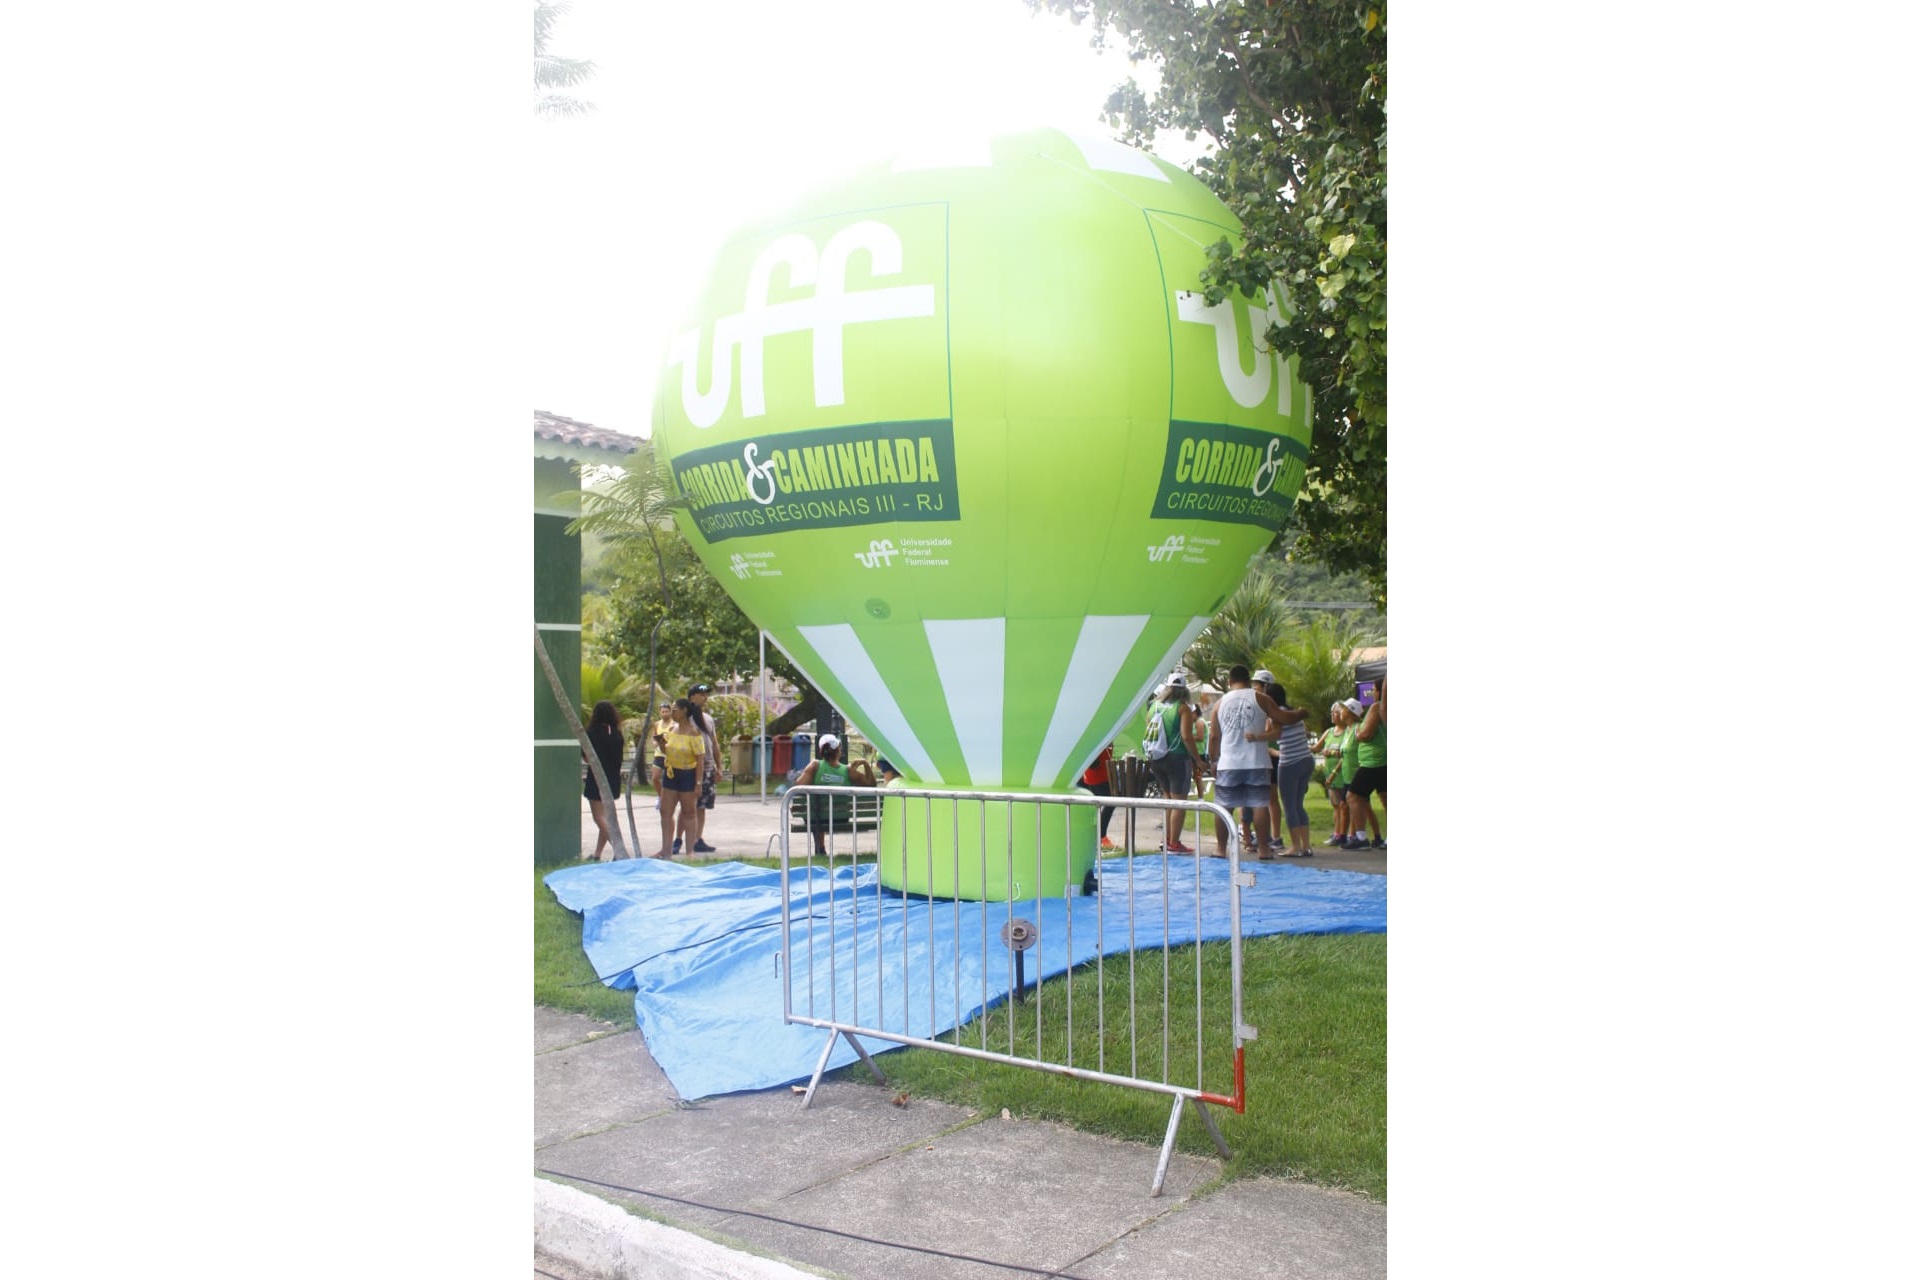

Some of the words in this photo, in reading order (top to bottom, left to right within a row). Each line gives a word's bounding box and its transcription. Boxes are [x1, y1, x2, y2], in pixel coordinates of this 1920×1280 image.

[680, 459, 755, 511] CORRIDA
[743, 442, 775, 505] &
[771, 437, 940, 494] CAMINHADA
[1176, 438, 1264, 489] CORRIDA
[1253, 438, 1284, 497] &
[700, 509, 765, 534] CIRCUITOS
[766, 495, 871, 524] REGIONAIS
[876, 493, 896, 513] III
[917, 493, 944, 512] RJ
[1167, 491, 1246, 515] CIRCUITOS
[901, 537, 953, 546] Universidade
[902, 548, 932, 556] Federal
[905, 558, 949, 567] Fluminense
